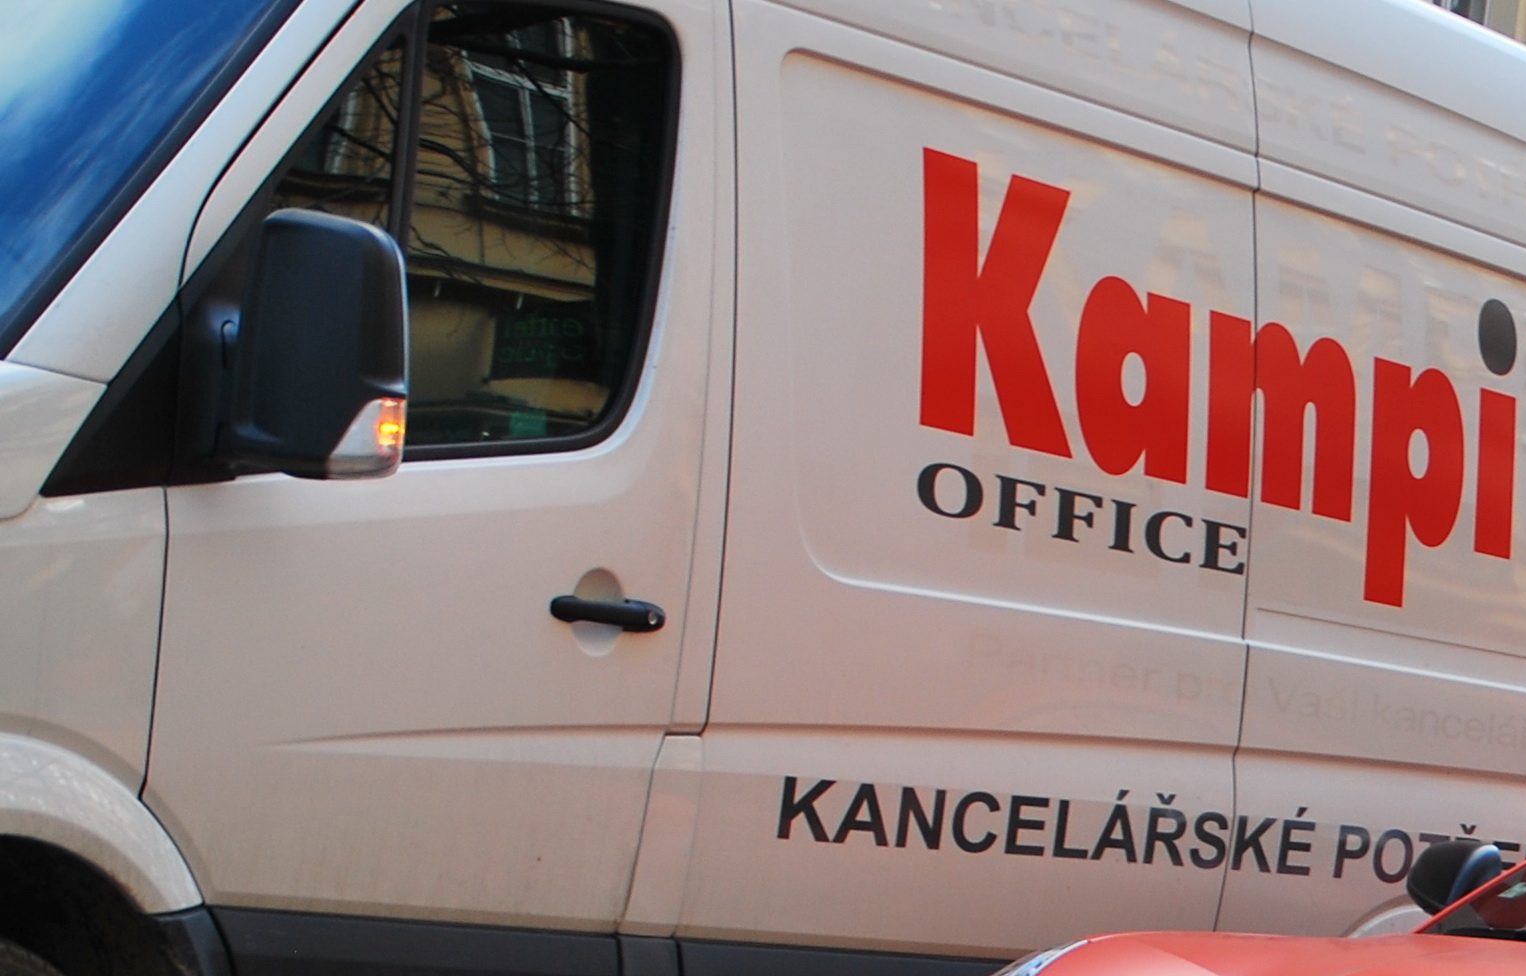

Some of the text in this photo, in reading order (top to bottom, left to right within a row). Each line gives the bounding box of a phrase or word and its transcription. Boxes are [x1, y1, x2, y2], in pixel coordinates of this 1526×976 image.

[919, 147, 1518, 609] Kampi
[915, 461, 1248, 577] OFFICE
[776, 775, 1317, 877] KANCELÁŘSKÉ
